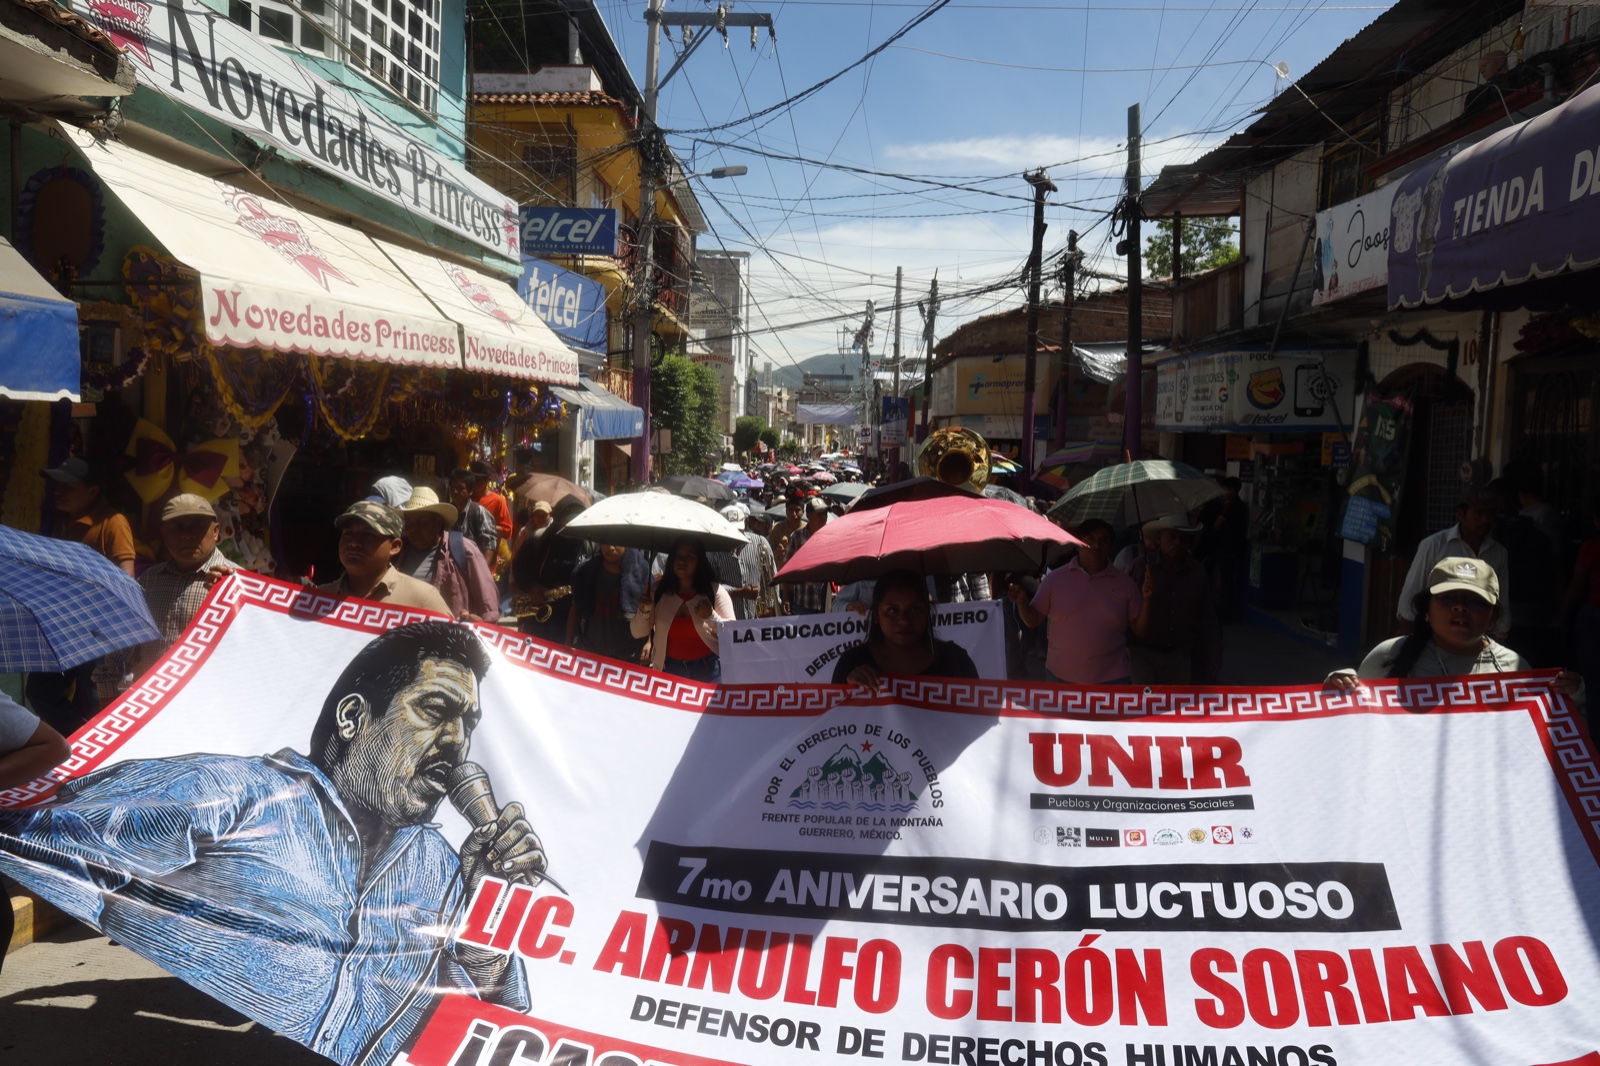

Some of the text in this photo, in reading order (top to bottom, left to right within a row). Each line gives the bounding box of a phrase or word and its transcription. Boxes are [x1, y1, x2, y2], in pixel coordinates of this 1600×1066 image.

[167, 0, 500, 247] Novedades Princess
[1453, 166, 1544, 240] TIENDA
[210, 288, 455, 355] Novedades Princess
[529, 267, 582, 328] telcel
[466, 336, 578, 376] Novedades Princess
[1252, 413, 1288, 424] telcel
[733, 609, 988, 643] LA EDUCACIÓN IMERO
[765, 724, 944, 808] POR EL DERECHO DE LOS PUEBLOS
[1029, 732, 1251, 789] UNIR
[762, 813, 943, 827] FRENTE POPULAR DE LA MONTAÑA
[799, 828, 903, 840] GUERRERO, MÉXICO.
[1048, 797, 1235, 811] Pueblos y Organizaciones Sociales
[676, 857, 1354, 922] 7mo ANIVERSARIO LUCTUOSO
[460, 880, 1568, 1029] LIC. ARNULFO CERÓN SORIANO
[630, 994, 820, 1051] DEFENSOR
[836, 1026, 886, 1059] DE
[901, 1032, 1107, 1066] DERECHOS
[1126, 1043, 1337, 1066] HUMANOS
